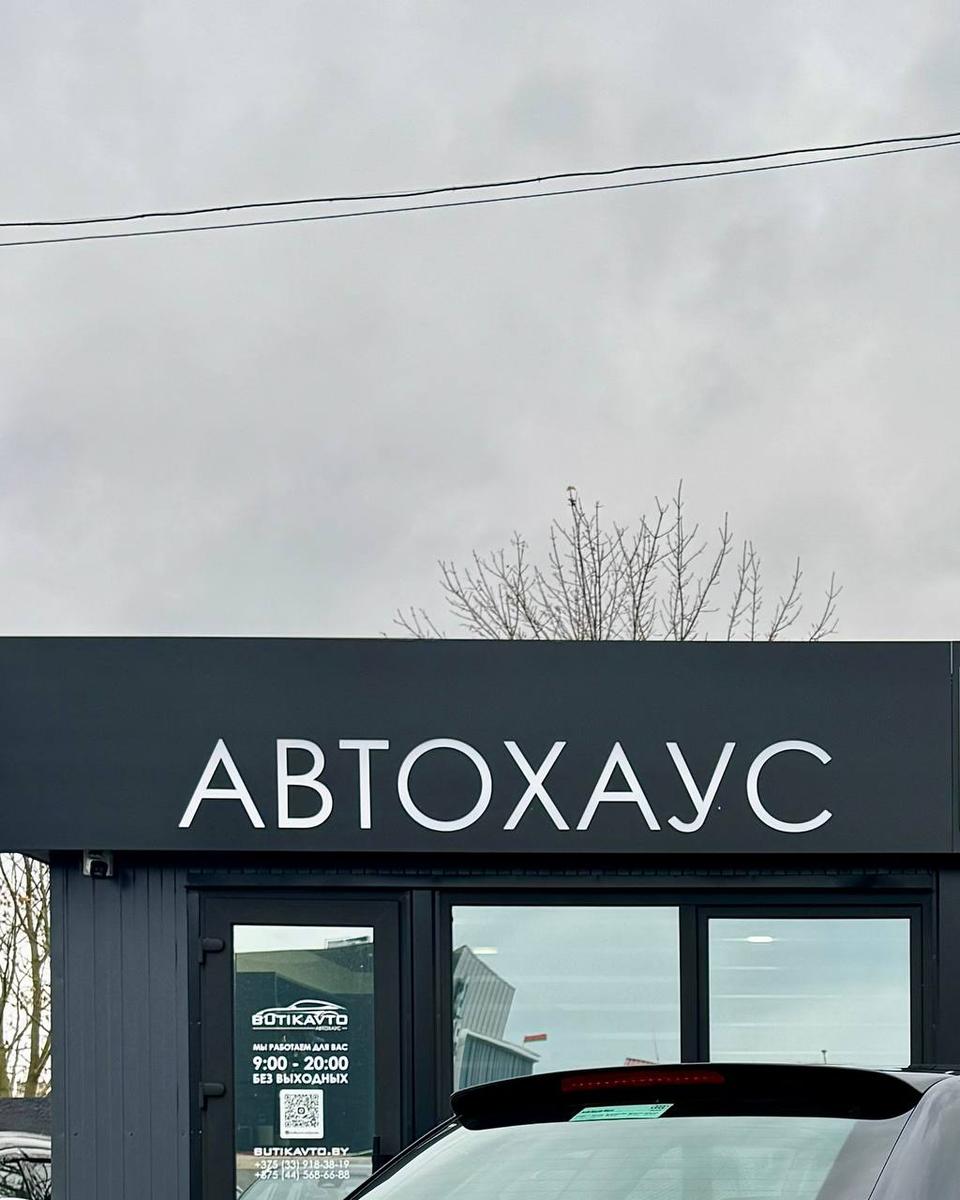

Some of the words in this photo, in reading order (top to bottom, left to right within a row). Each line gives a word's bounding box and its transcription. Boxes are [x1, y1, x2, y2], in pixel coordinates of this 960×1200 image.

[178, 738, 834, 834] АВТОХАУС
[251, 1014, 348, 1026] BUTIKAVTO
[253, 1043, 267, 1051] МЫ
[269, 1043, 311, 1051] РАБОТАЕМ
[312, 1043, 329, 1052] ДЛЯ
[331, 1043, 348, 1051] ВАС
[253, 1056, 287, 1071] 9:00
[304, 1056, 349, 1071] 20:00
[253, 1073, 272, 1084] БЕЗ
[276, 1073, 349, 1085] ВЫХОДНЫХ
[254, 1147, 350, 1156] BUTIKAVTO.BY
[254, 1160, 278, 1169] +375
[281, 1160, 300, 1170] (33)
[302, 1160, 350, 1169] 918-38-19
[281, 1170, 300, 1180] (44)
[303, 1170, 350, 1180] 568-66-88
